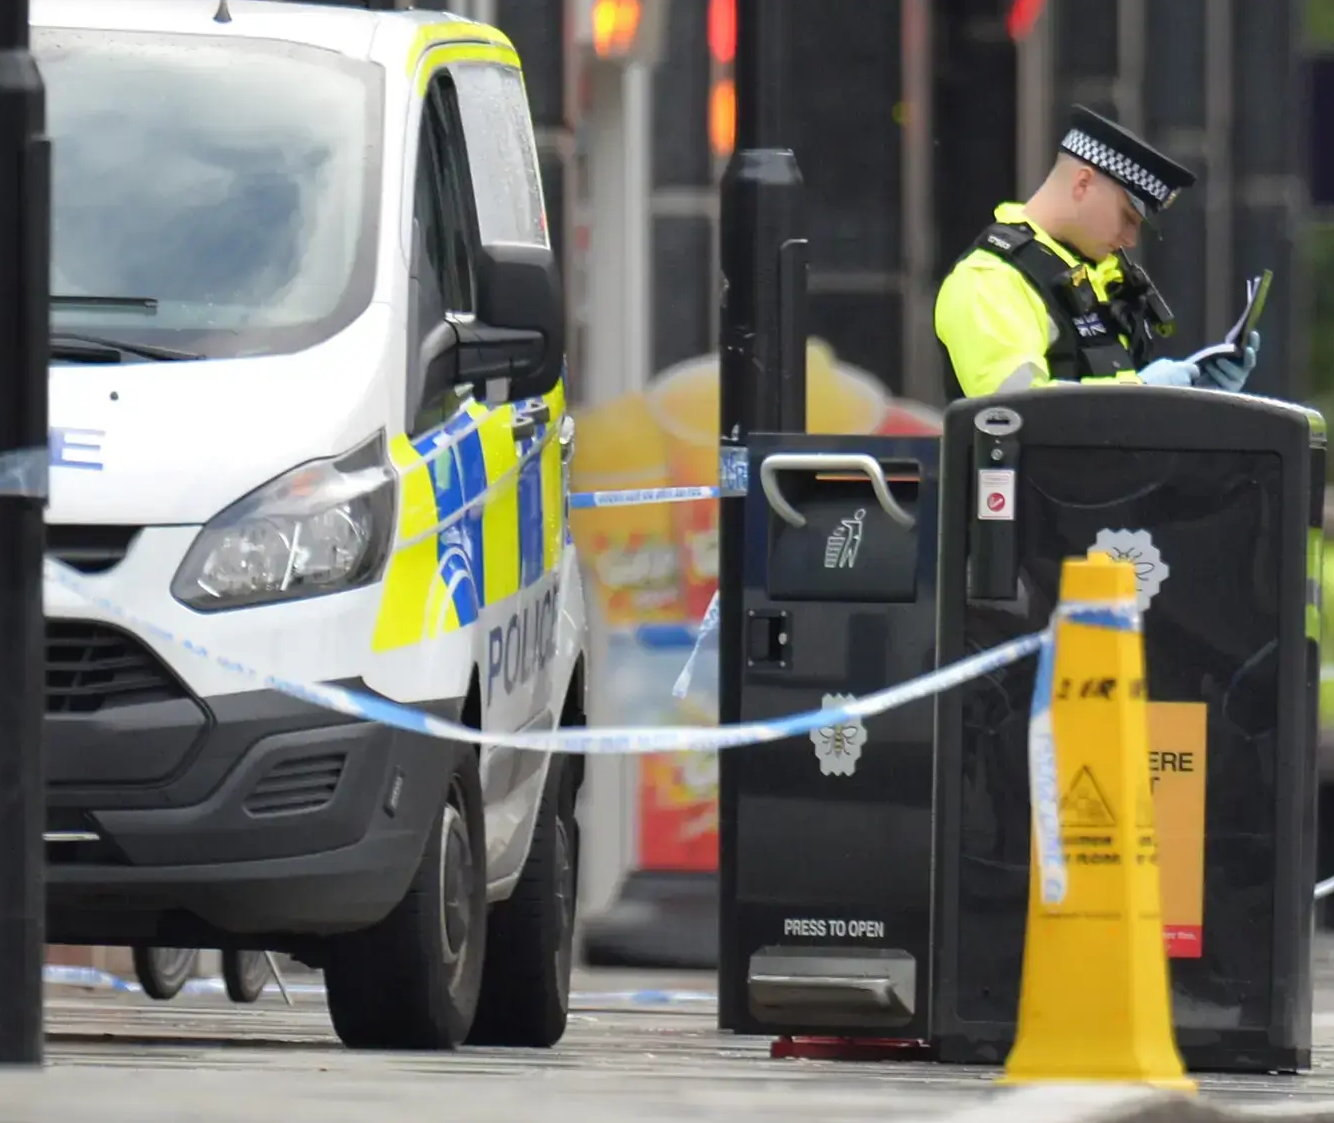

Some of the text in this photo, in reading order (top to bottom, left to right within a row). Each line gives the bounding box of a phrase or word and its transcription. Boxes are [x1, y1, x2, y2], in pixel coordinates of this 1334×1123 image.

[1147, 751, 1194, 772] ERE
[784, 918, 884, 938] PRESS TO OPEN
